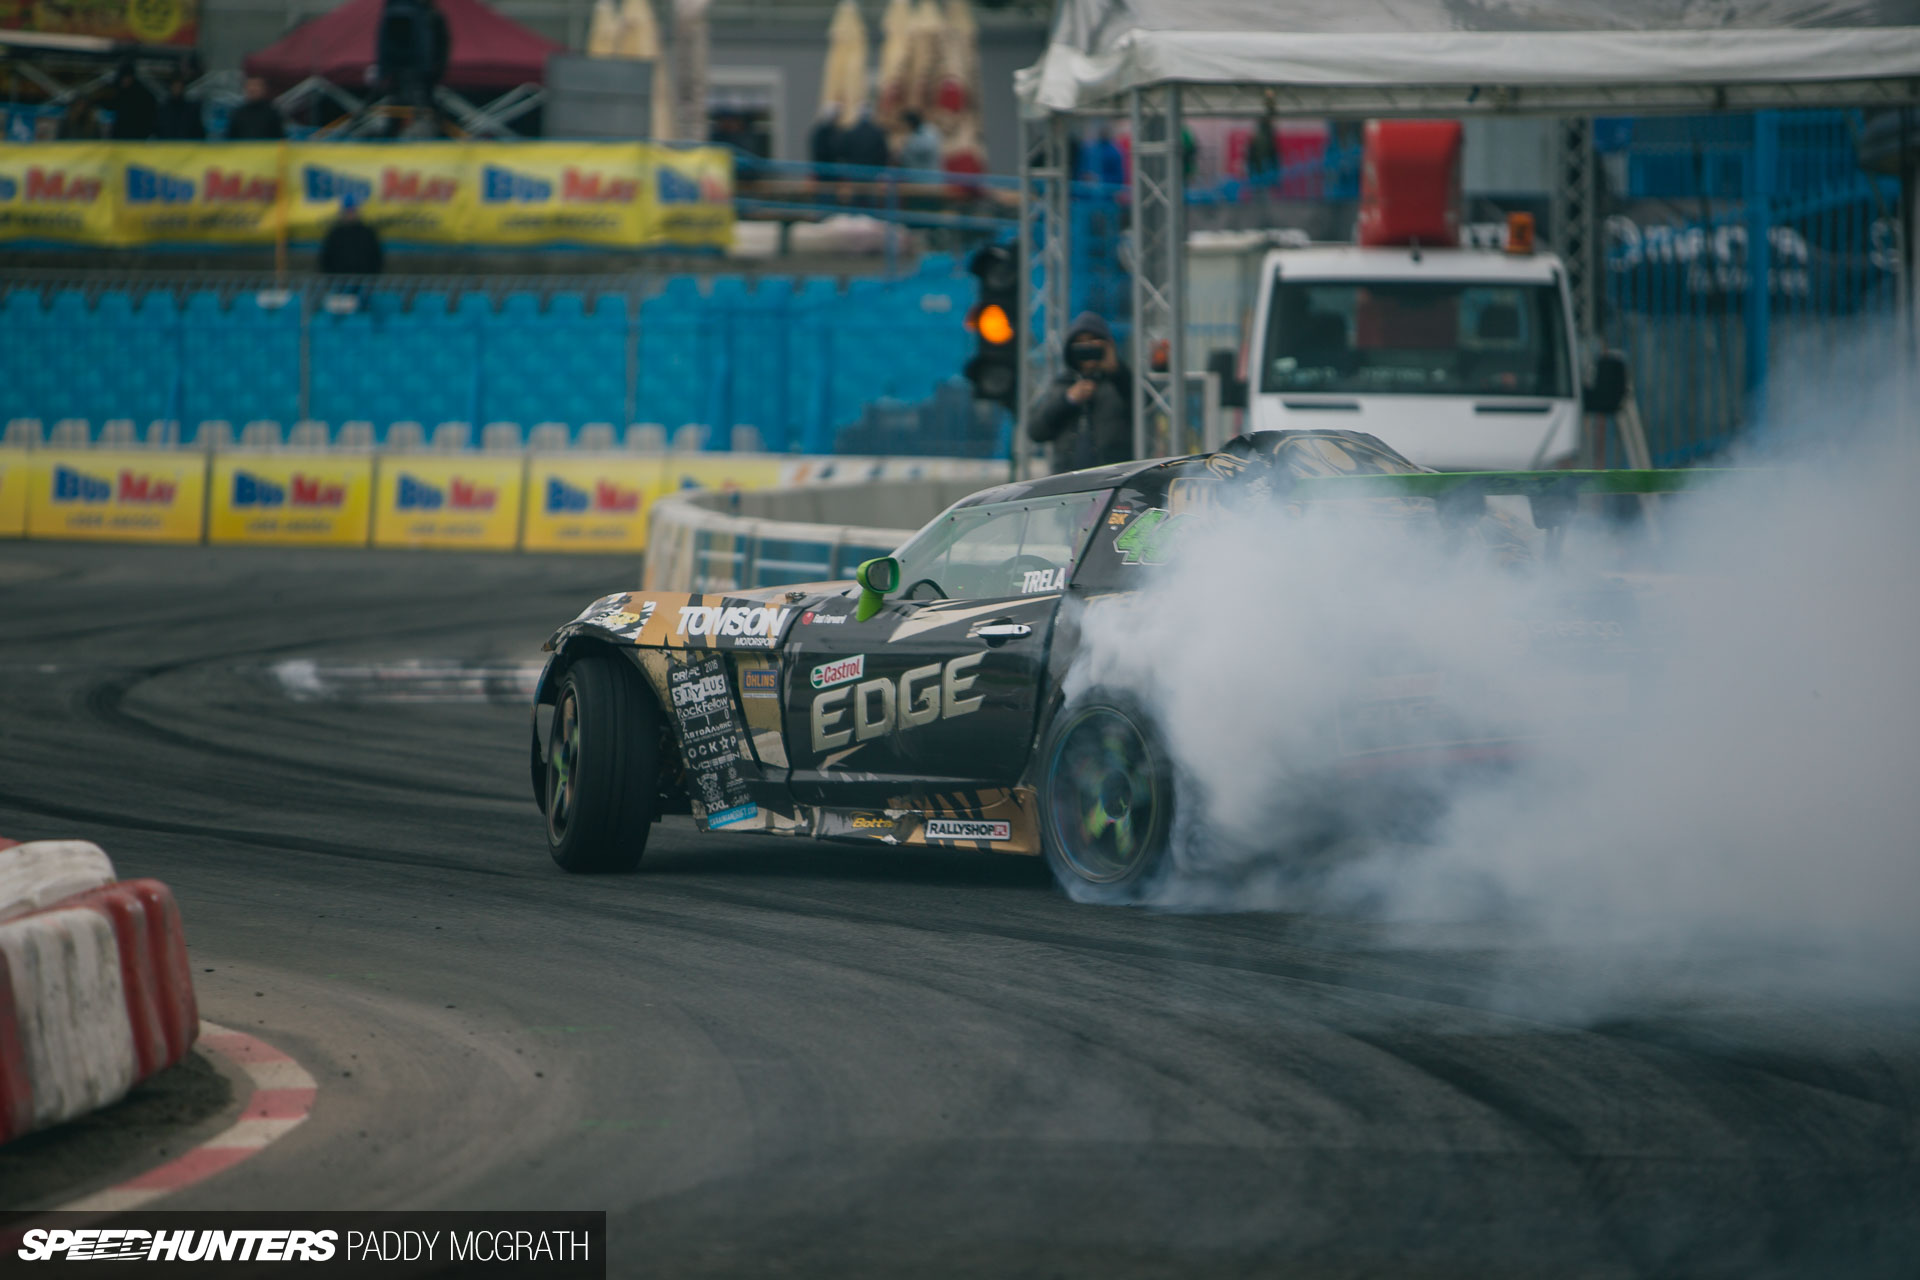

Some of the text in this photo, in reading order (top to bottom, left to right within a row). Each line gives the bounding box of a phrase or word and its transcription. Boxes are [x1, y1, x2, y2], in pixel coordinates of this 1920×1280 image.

[1021, 568, 1066, 594] TRELA
[676, 606, 790, 636] TOMSON
[734, 637, 777, 648] MOTORSPORT
[745, 671, 775, 688] ÖHLINS
[824, 658, 860, 683] Castrol
[673, 678, 724, 702] STYLUS
[811, 650, 990, 753] EDGE
